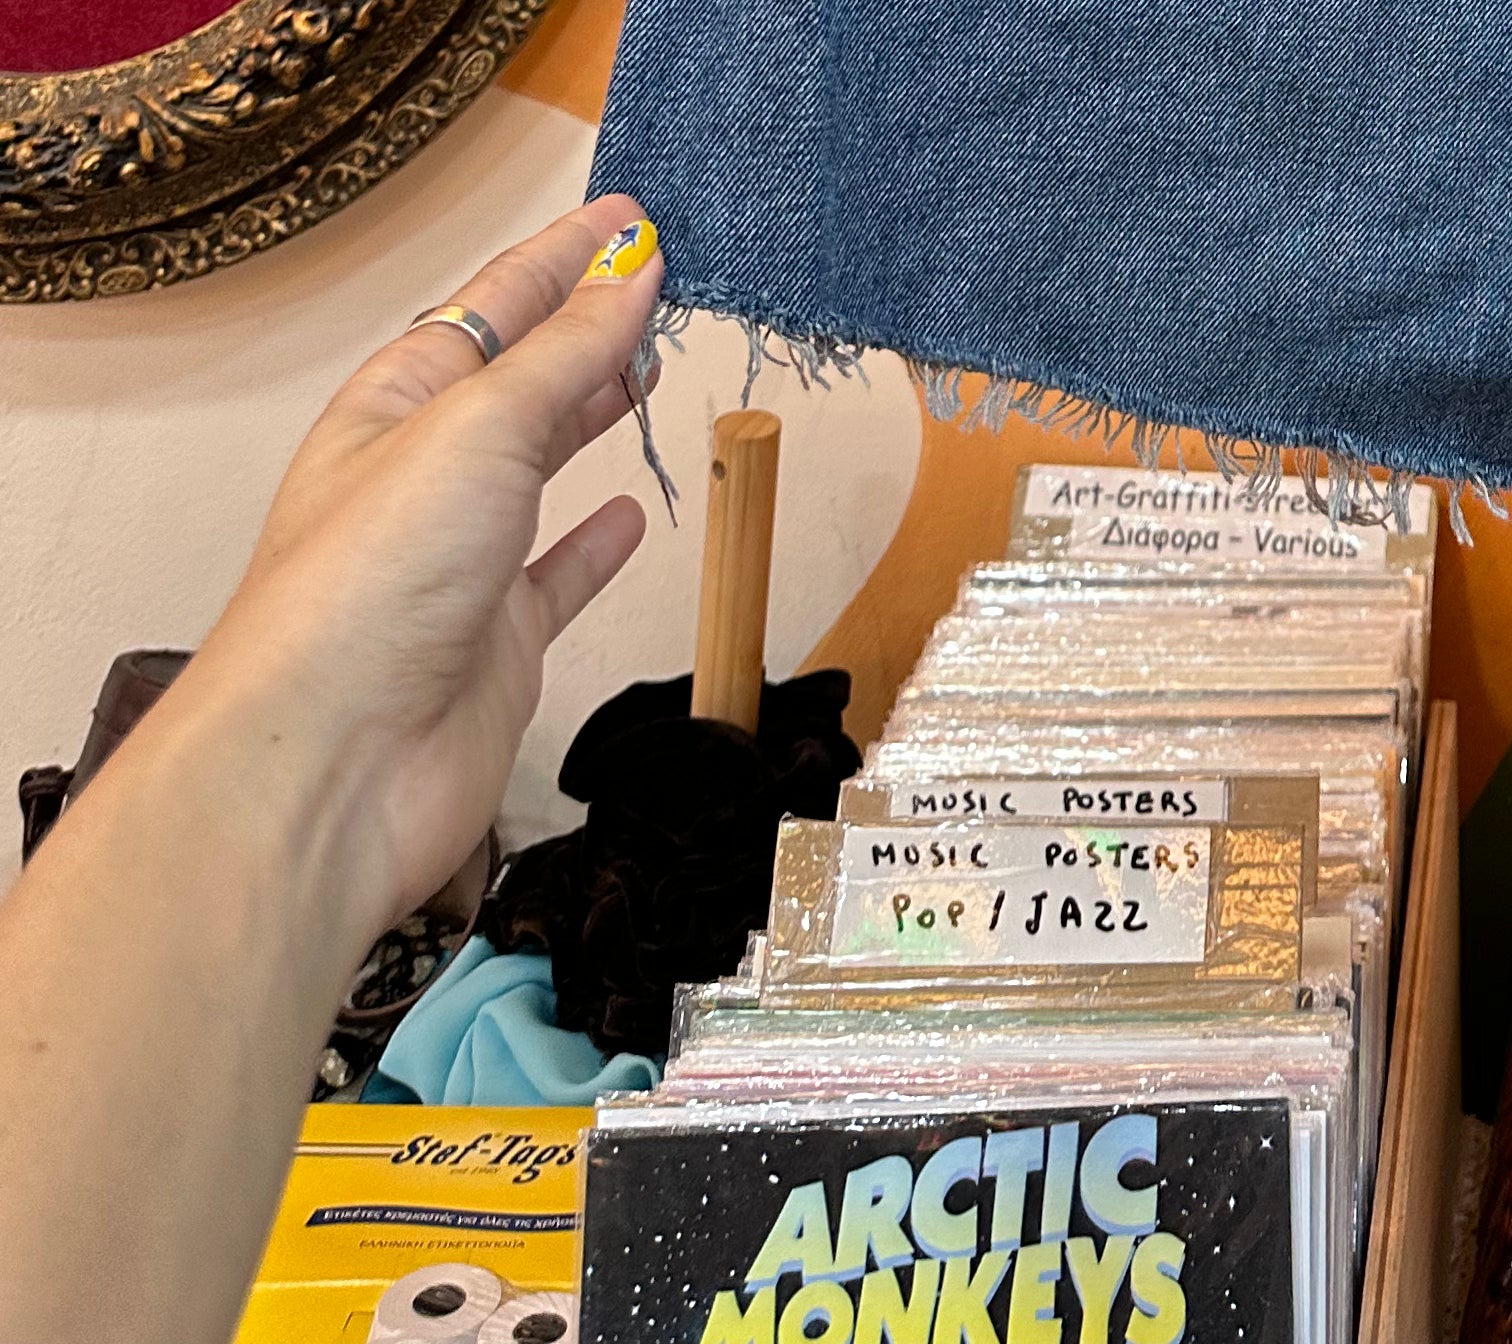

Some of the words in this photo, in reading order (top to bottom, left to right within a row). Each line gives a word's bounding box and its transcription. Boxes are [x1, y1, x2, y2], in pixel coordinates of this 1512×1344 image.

[1102, 517, 1220, 555] Διάφορα
[1254, 524, 1358, 559] Various
[911, 791, 1019, 815] MUSIC
[1062, 787, 1199, 817] POSTERS
[871, 841, 990, 869] MUSIC
[1044, 841, 1200, 872] POSTERS
[390, 1132, 578, 1185] Stef-Tags
[743, 1114, 1159, 1294] ARCTIC
[698, 1232, 1187, 1344] MONKEYS
